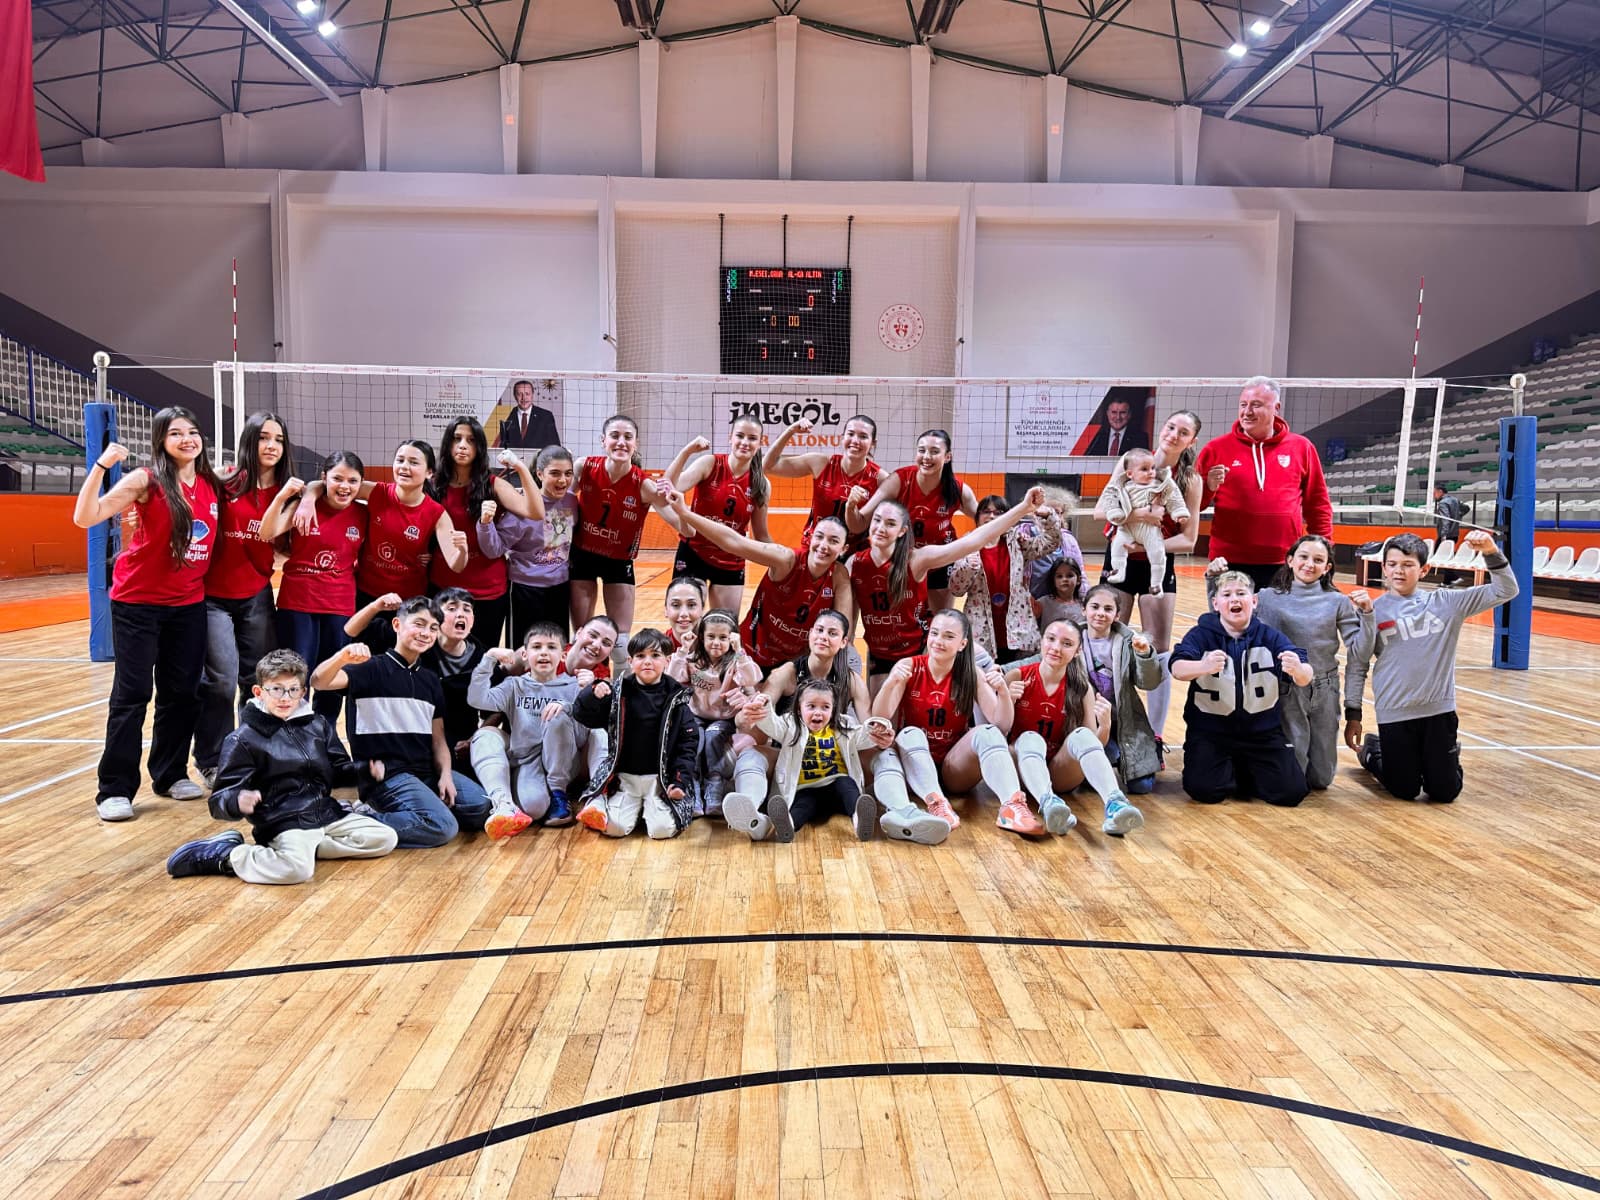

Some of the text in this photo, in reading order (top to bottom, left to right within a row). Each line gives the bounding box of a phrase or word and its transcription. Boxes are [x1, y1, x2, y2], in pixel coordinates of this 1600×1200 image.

[761, 347, 815, 360] 3 0
[787, 434, 842, 447] ALONU
[723, 498, 736, 516] 3
[870, 591, 890, 612] 13
[1378, 611, 1445, 645] FILA
[928, 707, 947, 727] 18
[1037, 719, 1055, 739] 11
